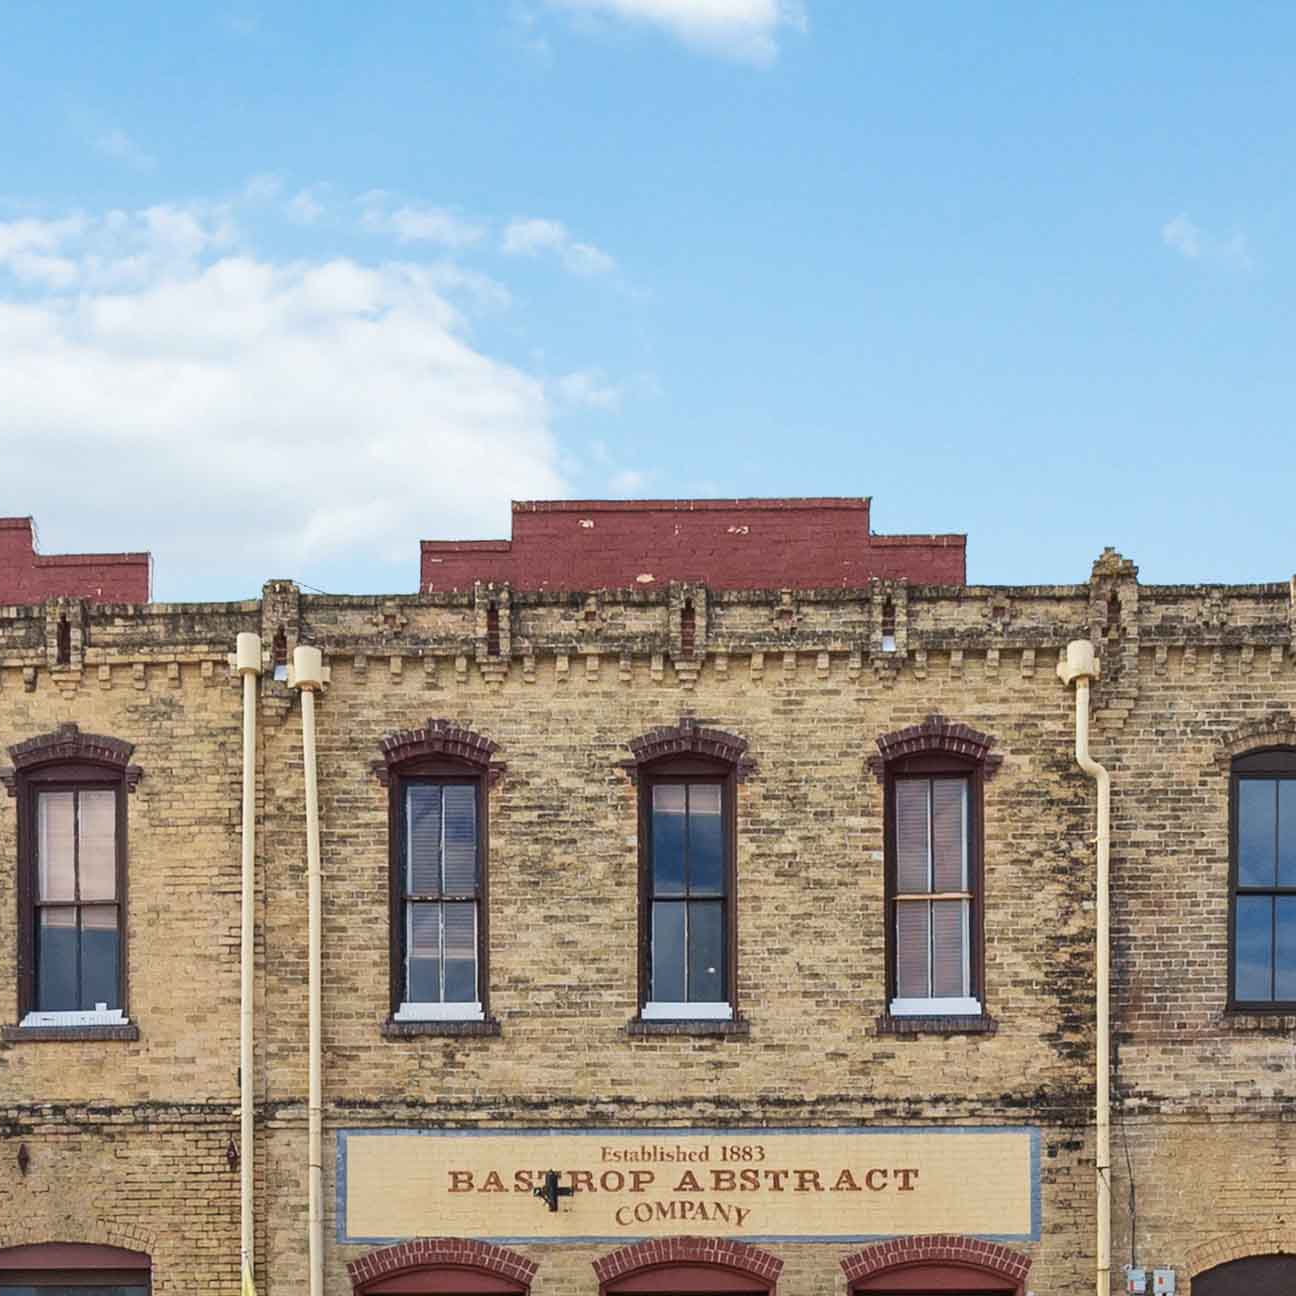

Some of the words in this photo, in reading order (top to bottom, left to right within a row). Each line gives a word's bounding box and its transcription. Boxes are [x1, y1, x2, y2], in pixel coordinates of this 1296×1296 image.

[600, 1145, 710, 1163] Established
[720, 1145, 766, 1162] 1883
[673, 1168, 920, 1192] ABSTRACT
[615, 1200, 752, 1228] COMPANY
